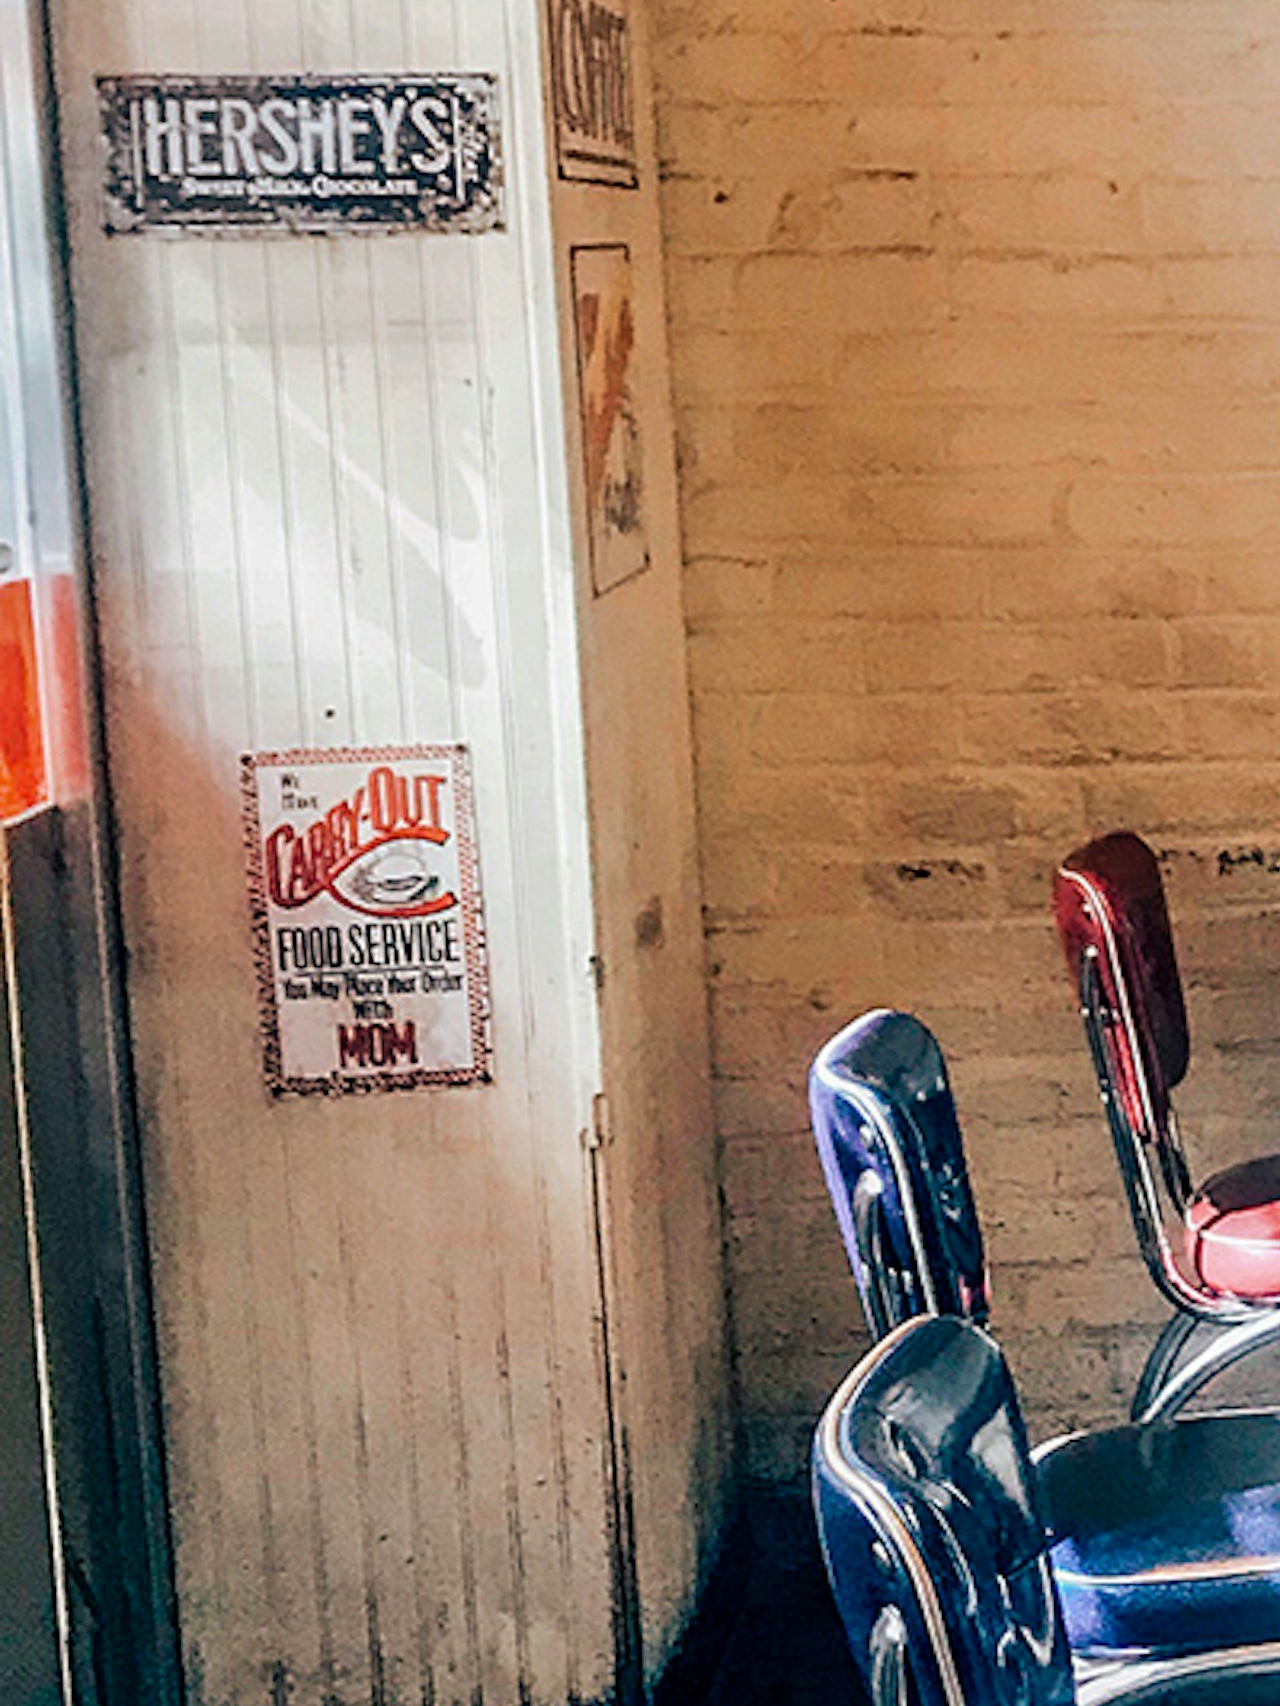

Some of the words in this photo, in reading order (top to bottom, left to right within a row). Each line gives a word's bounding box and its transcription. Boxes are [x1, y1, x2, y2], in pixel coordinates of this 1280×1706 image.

[145, 97, 450, 176] HERSHEY'S
[268, 767, 447, 908] CARRY-OUT
[278, 927, 341, 970] FOOD
[349, 920, 460, 966] SERVICE
[338, 1021, 418, 1067] MOM
